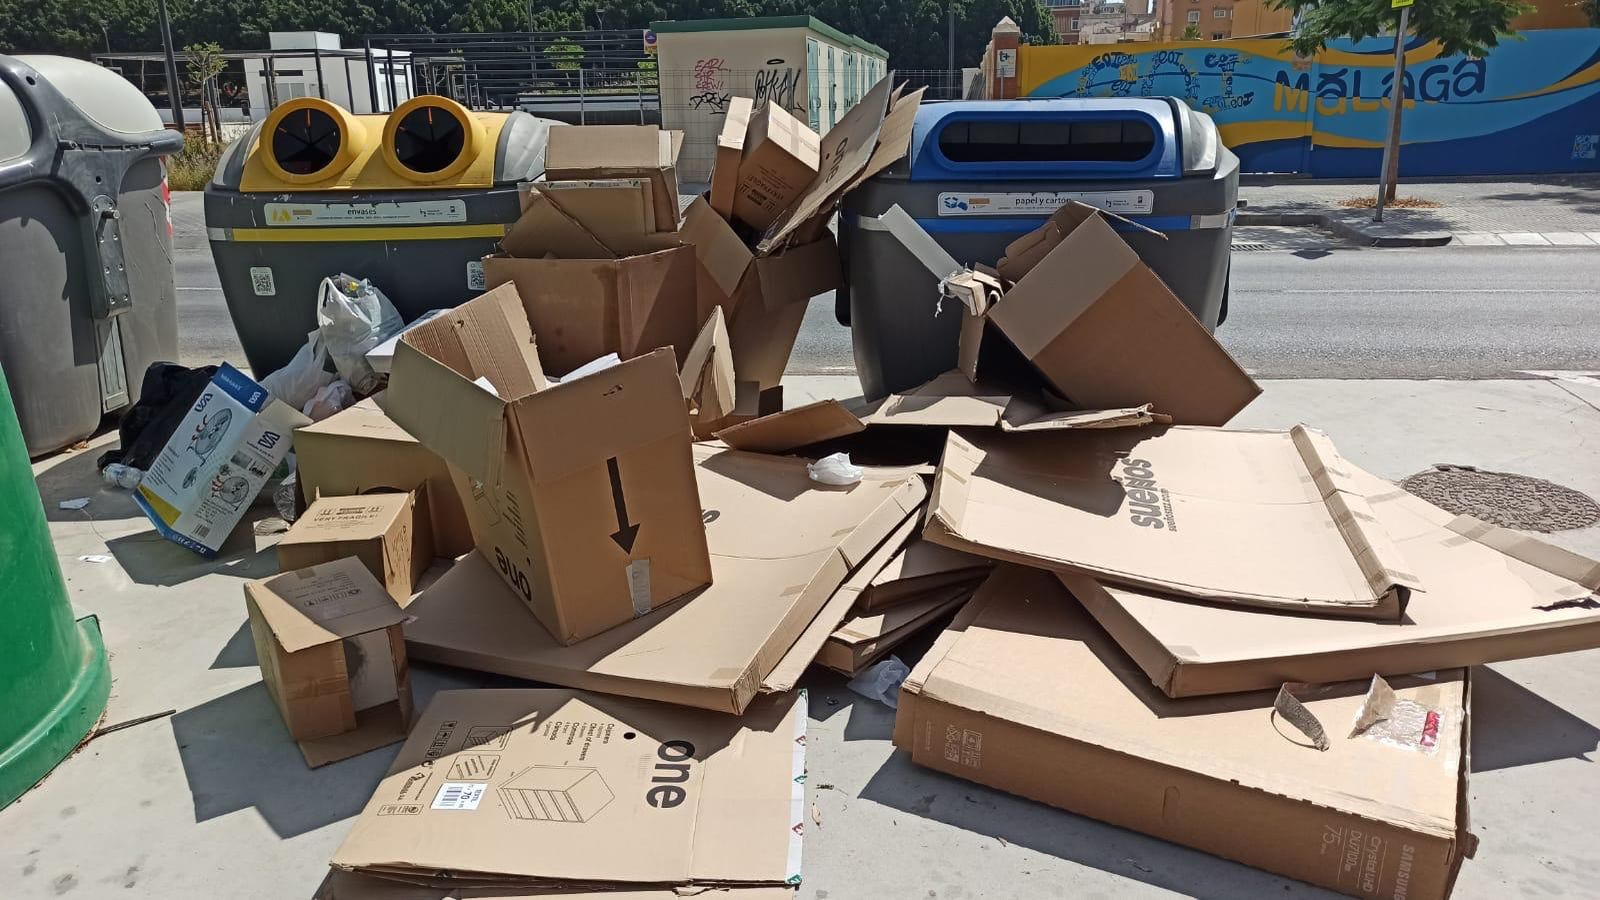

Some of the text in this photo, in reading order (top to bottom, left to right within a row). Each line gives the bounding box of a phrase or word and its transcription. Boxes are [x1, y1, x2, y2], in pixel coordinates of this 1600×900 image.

[347, 206, 377, 216] envases
[1015, 195, 1072, 207] papel y cartón
[494, 545, 532, 602] one
[645, 739, 697, 809] one
[1322, 824, 1342, 844] 75
[1366, 836, 1382, 873] Crystal
[1393, 844, 1415, 900] SAMSUNG
